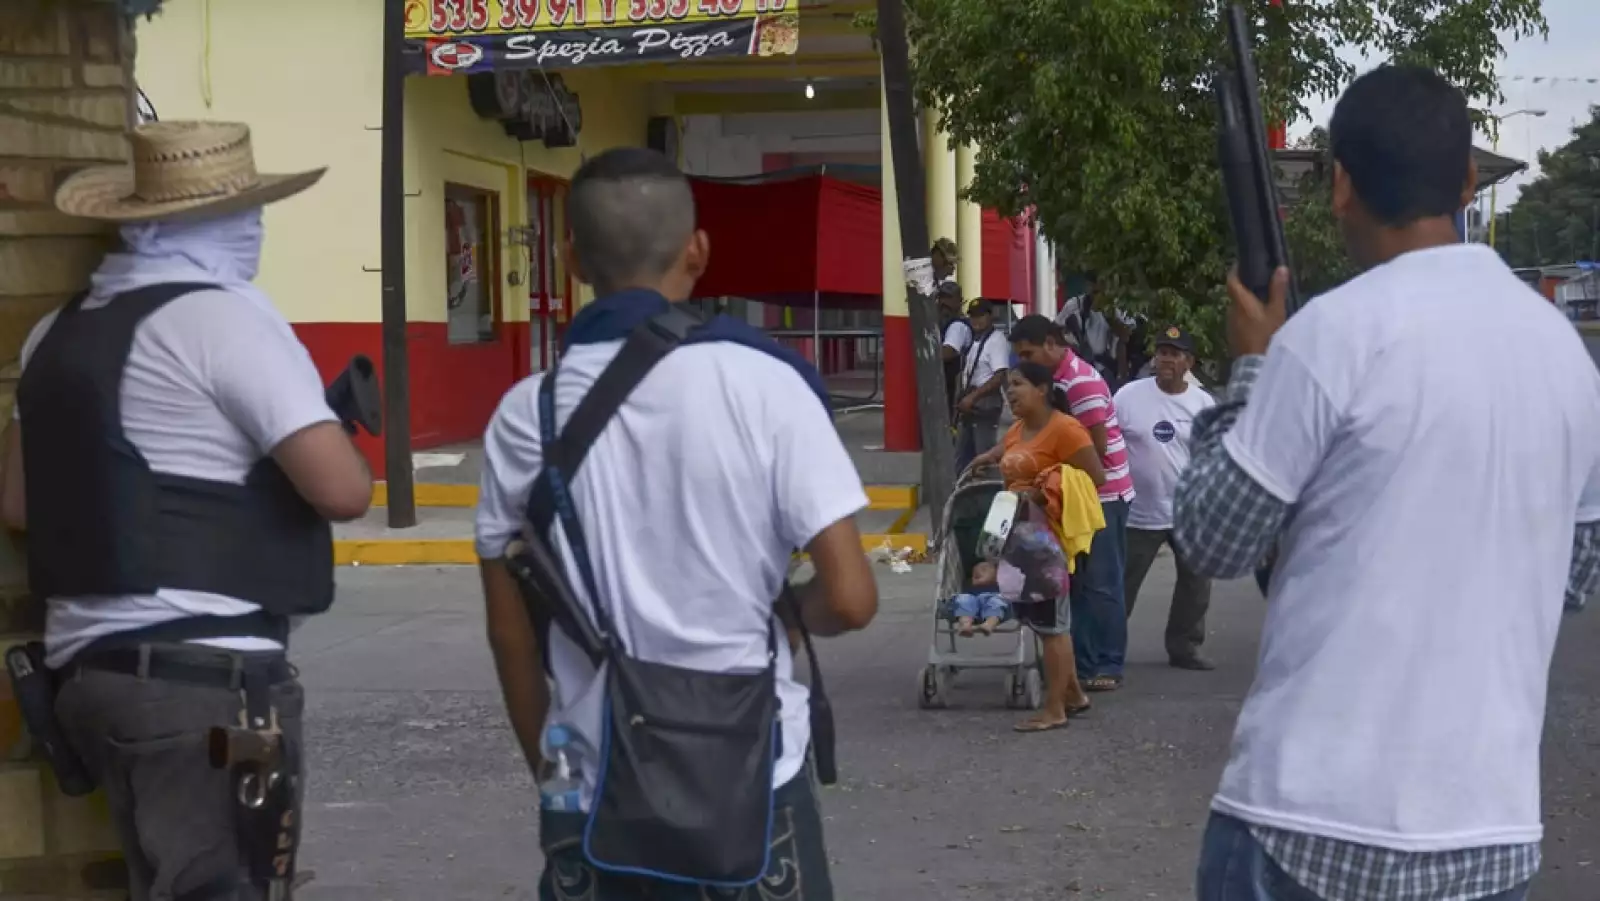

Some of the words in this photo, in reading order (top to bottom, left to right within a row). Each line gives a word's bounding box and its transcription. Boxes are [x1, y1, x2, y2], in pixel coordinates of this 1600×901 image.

[430, 0, 488, 32] 535
[499, 0, 539, 29] 39
[505, 34, 624, 64] Spezia
[632, 28, 734, 58] Pizza
